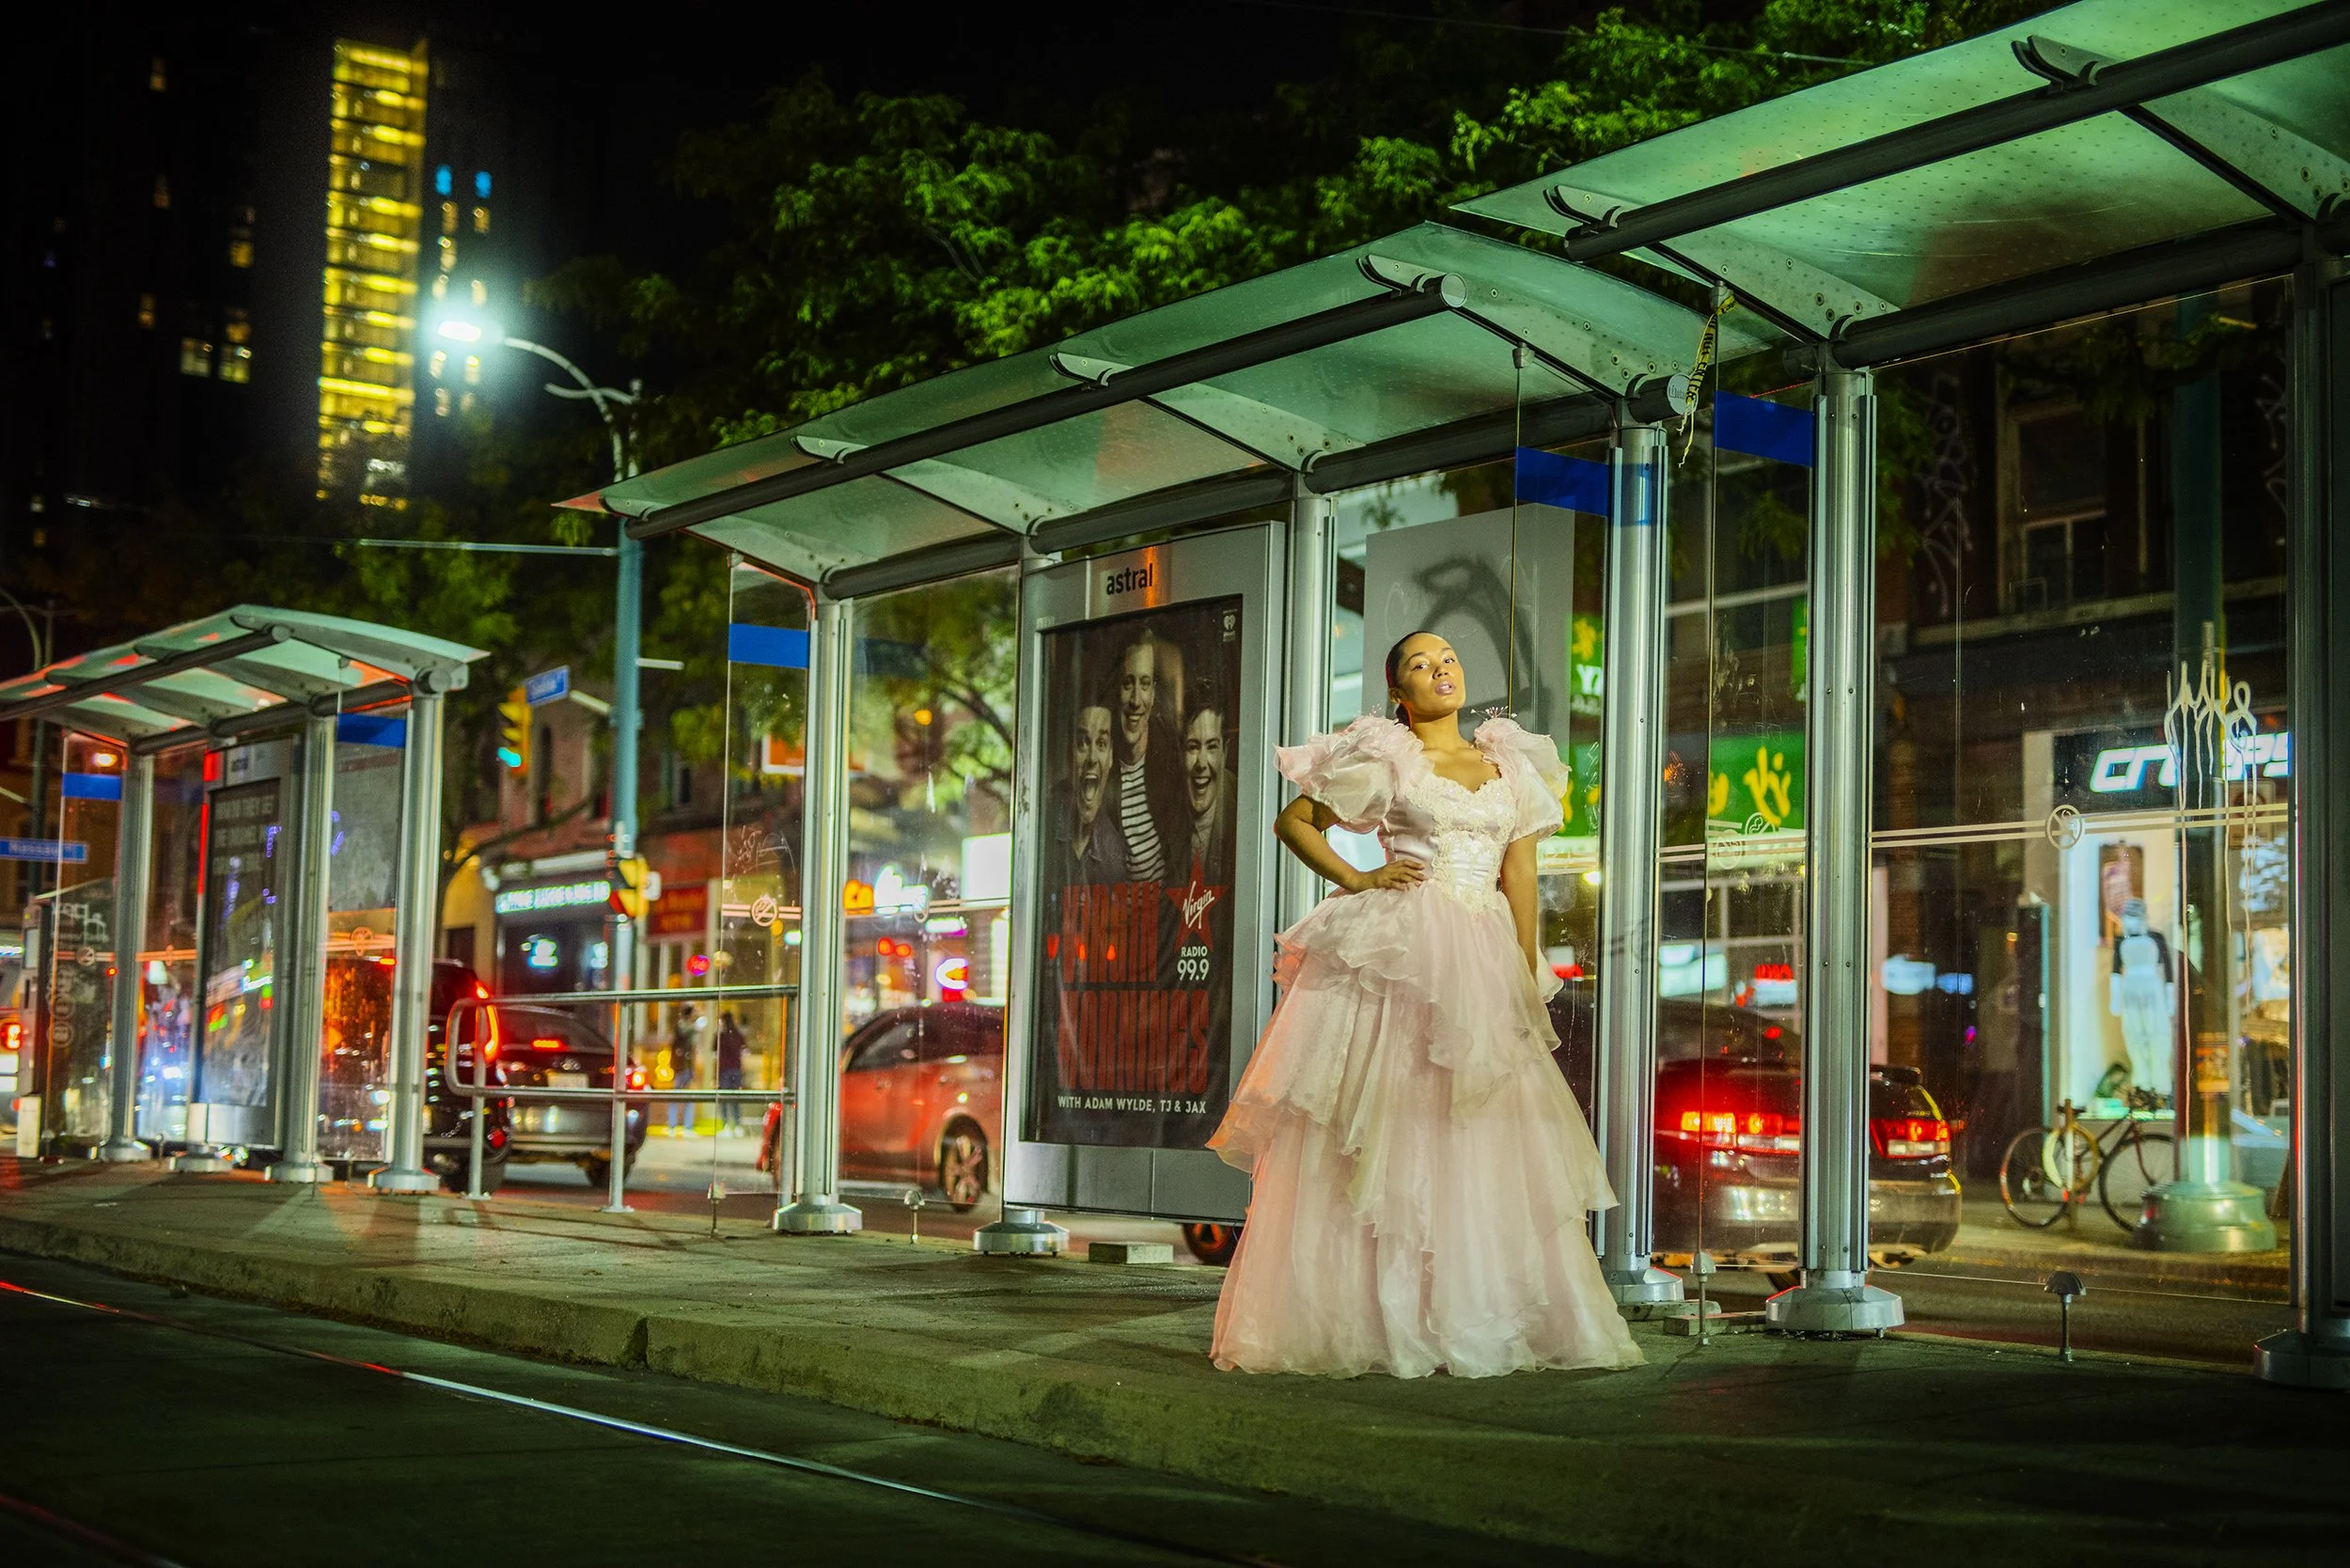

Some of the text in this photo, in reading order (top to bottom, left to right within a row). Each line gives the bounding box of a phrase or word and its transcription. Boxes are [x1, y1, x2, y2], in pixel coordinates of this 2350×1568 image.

[1106, 562, 1153, 595] astral
[1182, 880, 1215, 930] Virgin
[1063, 881, 1159, 983] VIRGIN
[1180, 945, 1209, 958] RADIO
[1177, 959, 1210, 981] 99.9
[1057, 989, 1210, 1094] MORNINGS
[1058, 1095, 1206, 1114] WITH ADAM WYLDE, TJ & JAX
